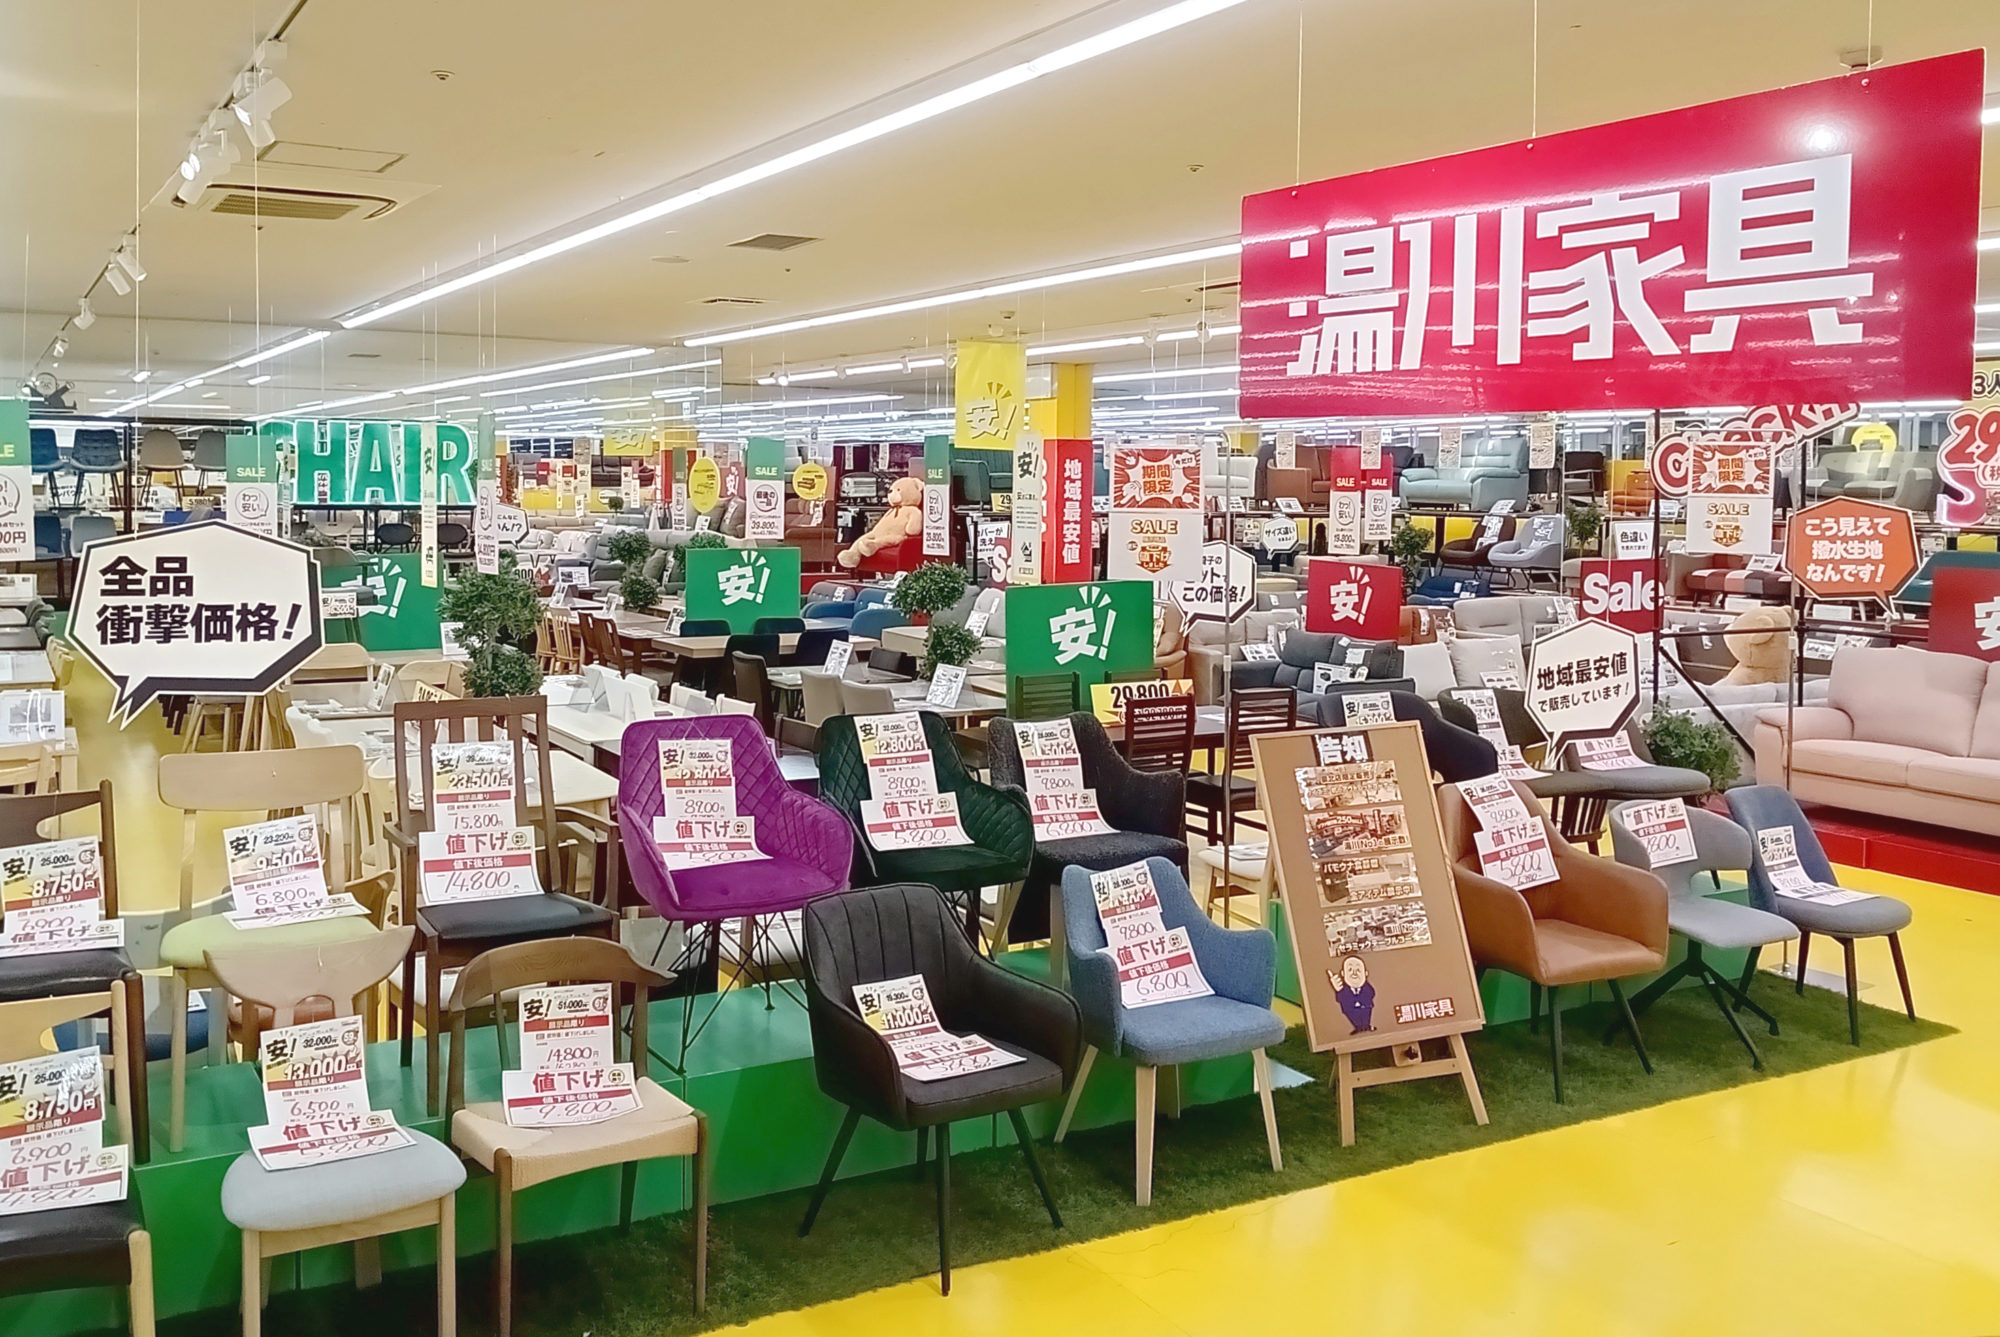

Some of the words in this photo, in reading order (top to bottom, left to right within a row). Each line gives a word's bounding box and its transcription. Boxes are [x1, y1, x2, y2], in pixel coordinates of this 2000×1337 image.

[1287, 154, 1873, 376] 湯川家具
[966, 398, 1017, 440] 安!
[237, 467, 266, 477] SALE
[755, 467, 778, 476] SALE
[928, 468, 943, 479] SALE
[1017, 451, 1039, 478] 安!
[1142, 464, 1171, 479] 期間
[1718, 458, 1744, 470] 期間
[1142, 480, 1173, 495] 限定
[1336, 478, 1355, 487] SALE
[1371, 478, 1388, 486] SALE
[1718, 471, 1745, 482] 限定
[1062, 459, 1083, 564] 地域最安値
[1707, 503, 1750, 516] SALE
[977, 526, 1004, 537] バーが
[1131, 519, 1179, 534] SALE
[1621, 531, 1648, 542] 色違い
[1804, 517, 1892, 536] こう見えて
[1812, 540, 1883, 560] 撥水生地
[100, 556, 195, 597] 全品
[1806, 563, 1885, 583] なんです!
[717, 564, 771, 606] 安!
[1583, 571, 1664, 615] Sale
[1329, 580, 1373, 626] 安!
[95, 603, 302, 645] 衝撃価格!
[1049, 607, 1117, 666] 安!
[1537, 652, 1628, 691] 地域最安値
[1537, 682, 1630, 712] で販売しています!
[860, 723, 879, 738] 安!
[662, 748, 685, 765] 安!
[1317, 734, 1369, 764] 告知
[882, 798, 934, 819] 値下げ
[1034, 793, 1077, 811] 値下げ
[1633, 804, 1666, 826] 値下げ
[676, 820, 731, 839] 値下げ
[1491, 823, 1528, 848] 値下げ
[229, 834, 257, 856] 安!
[445, 831, 509, 855] 値下げ
[3, 856, 35, 878] 安!
[32, 873, 96, 899] 8,750円
[254, 899, 324, 916] 値下げ
[11, 924, 91, 944] 値下げ
[1117, 936, 1166, 966] 値下げ
[524, 998, 553, 1020] 安!
[859, 993, 882, 1012] 安!
[1396, 999, 1454, 1023] 湯川家具
[266, 1038, 297, 1062] 安!
[532, 1069, 605, 1094] 値下げ
[23, 1091, 96, 1122] 8,750円
[542, 1092, 600, 1104] 値下後価格
[283, 1116, 361, 1142] 値下げ
[1, 1154, 91, 1189] 値下げ
